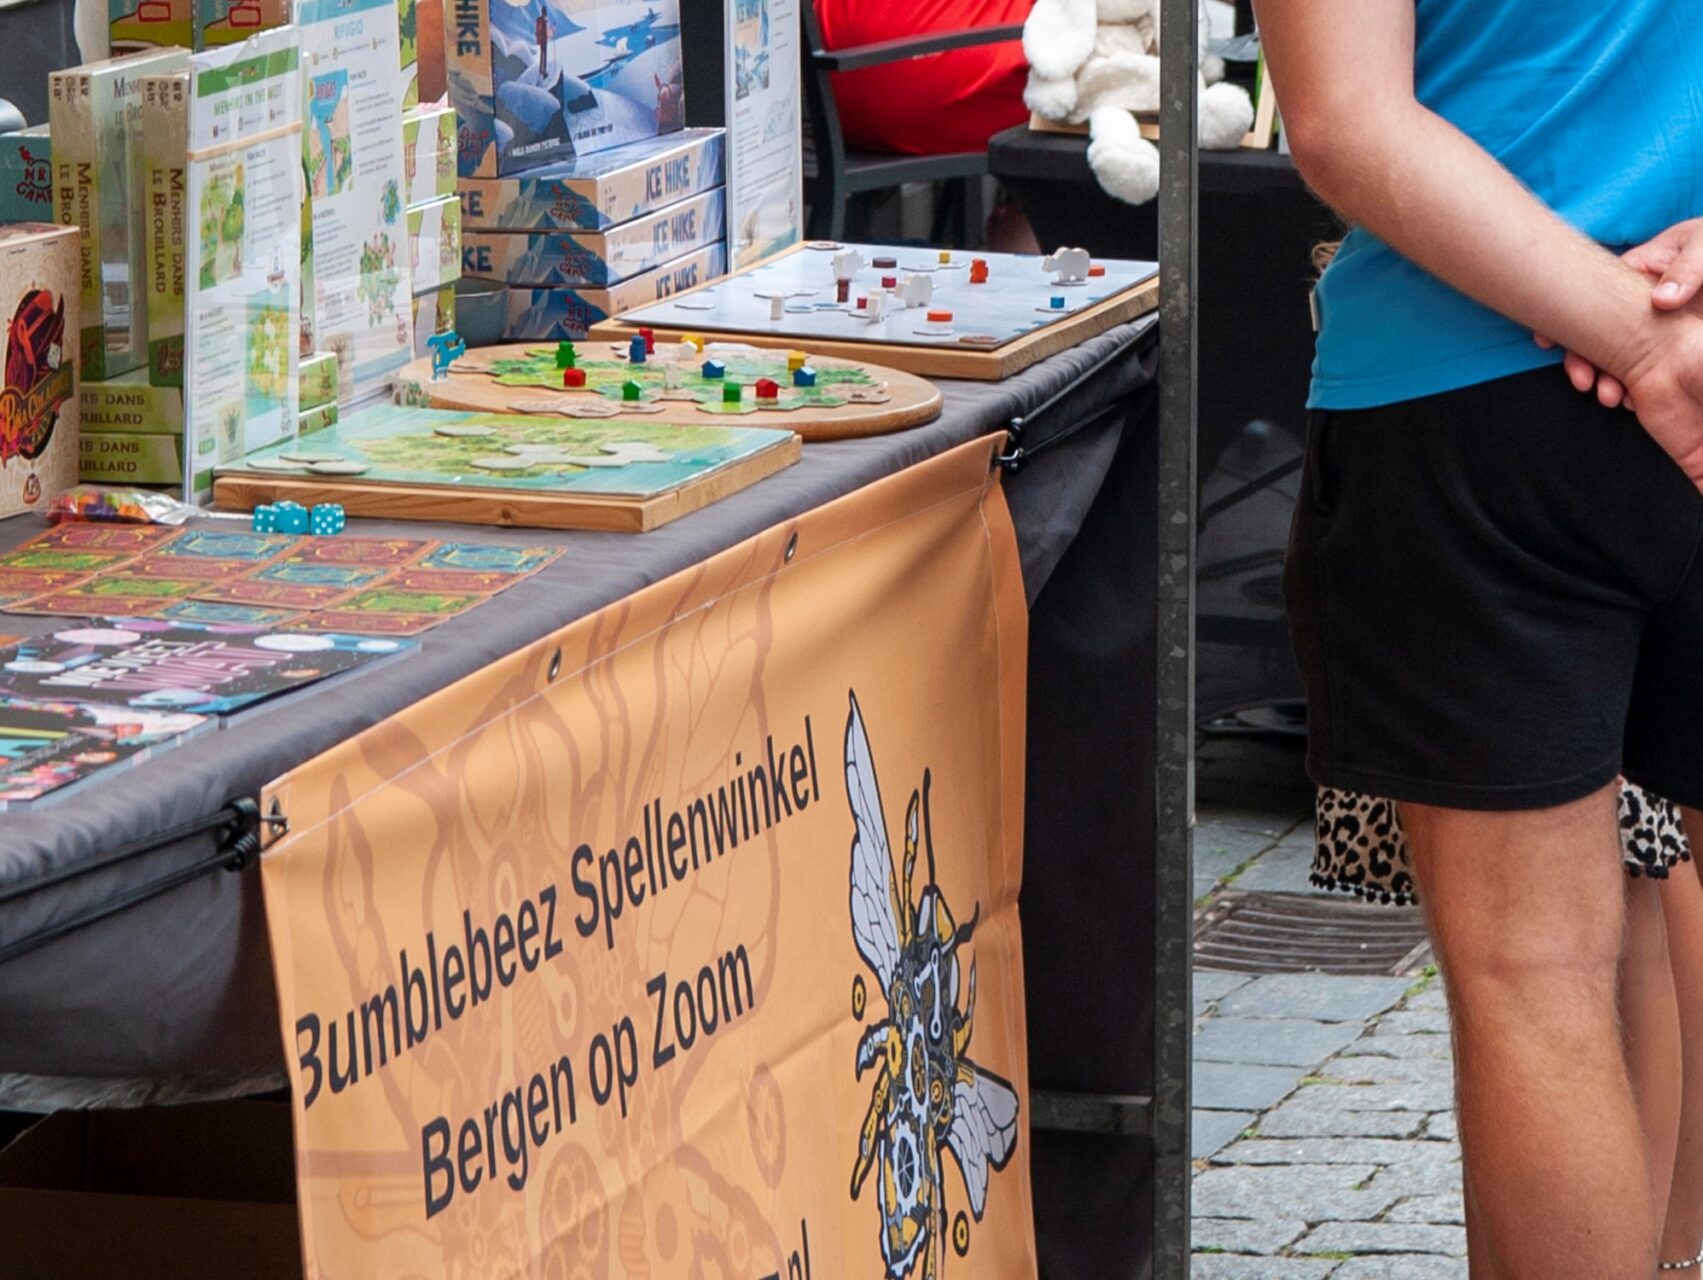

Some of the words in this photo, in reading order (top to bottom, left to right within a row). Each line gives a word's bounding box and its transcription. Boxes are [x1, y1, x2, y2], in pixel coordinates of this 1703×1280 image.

[645, 166, 662, 202] ICE
[664, 154, 690, 194] HIKE
[170, 168, 183, 246] MENHIRS
[153, 192, 166, 293] BROUILLARD
[653, 220, 669, 257] ICE
[671, 209, 696, 244] HIKE
[81, 247, 92, 289] DANS
[172, 253, 183, 296] DANS
[656, 274, 671, 300] ICE
[674, 262, 698, 293] HIKE
[106, 394, 144, 406] DANS
[101, 442, 139, 453] DANS
[295, 884, 563, 1110] Bumblebeez
[570, 715, 821, 950] Spellenwinkel
[420, 1050, 578, 1219] Bergen
[588, 1013, 638, 1118] op
[645, 942, 755, 1068] Zoom
